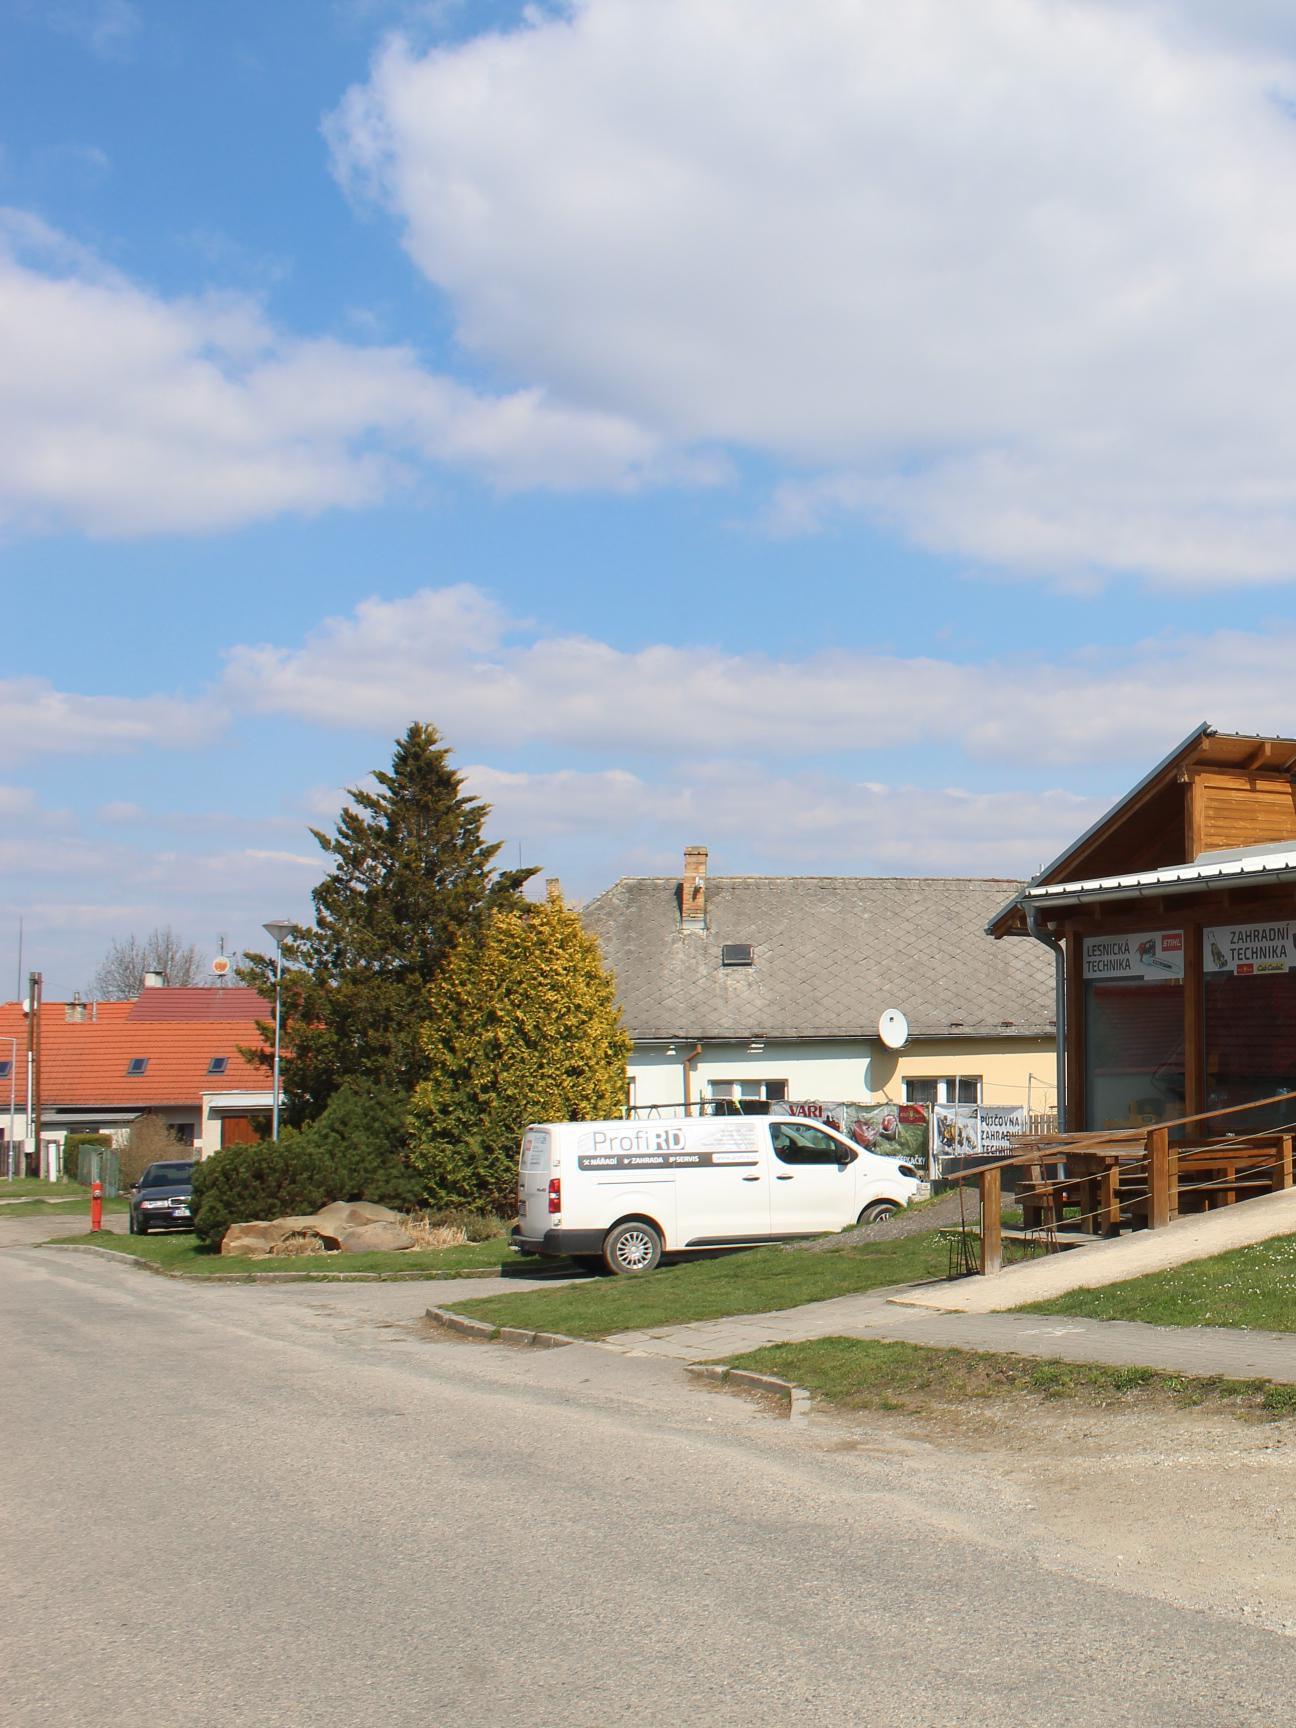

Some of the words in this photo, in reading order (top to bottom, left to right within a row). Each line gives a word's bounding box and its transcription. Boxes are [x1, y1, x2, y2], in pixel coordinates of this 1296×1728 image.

[1230, 922, 1290, 944] ZAHRADNÍ
[1087, 939, 1130, 957] LESNICKÁ
[1230, 945, 1287, 961] TECHNIKA
[1086, 958, 1131, 973] TECHNIKA
[789, 1105, 822, 1118] VARI
[980, 1113, 1019, 1127] PŮJČOVNA
[592, 1128, 687, 1152] ProfiRD
[982, 1144, 1014, 1155] TECHNIK
[631, 1156, 664, 1164] ZAHRADA
[676, 1155, 699, 1163] SERVIS
